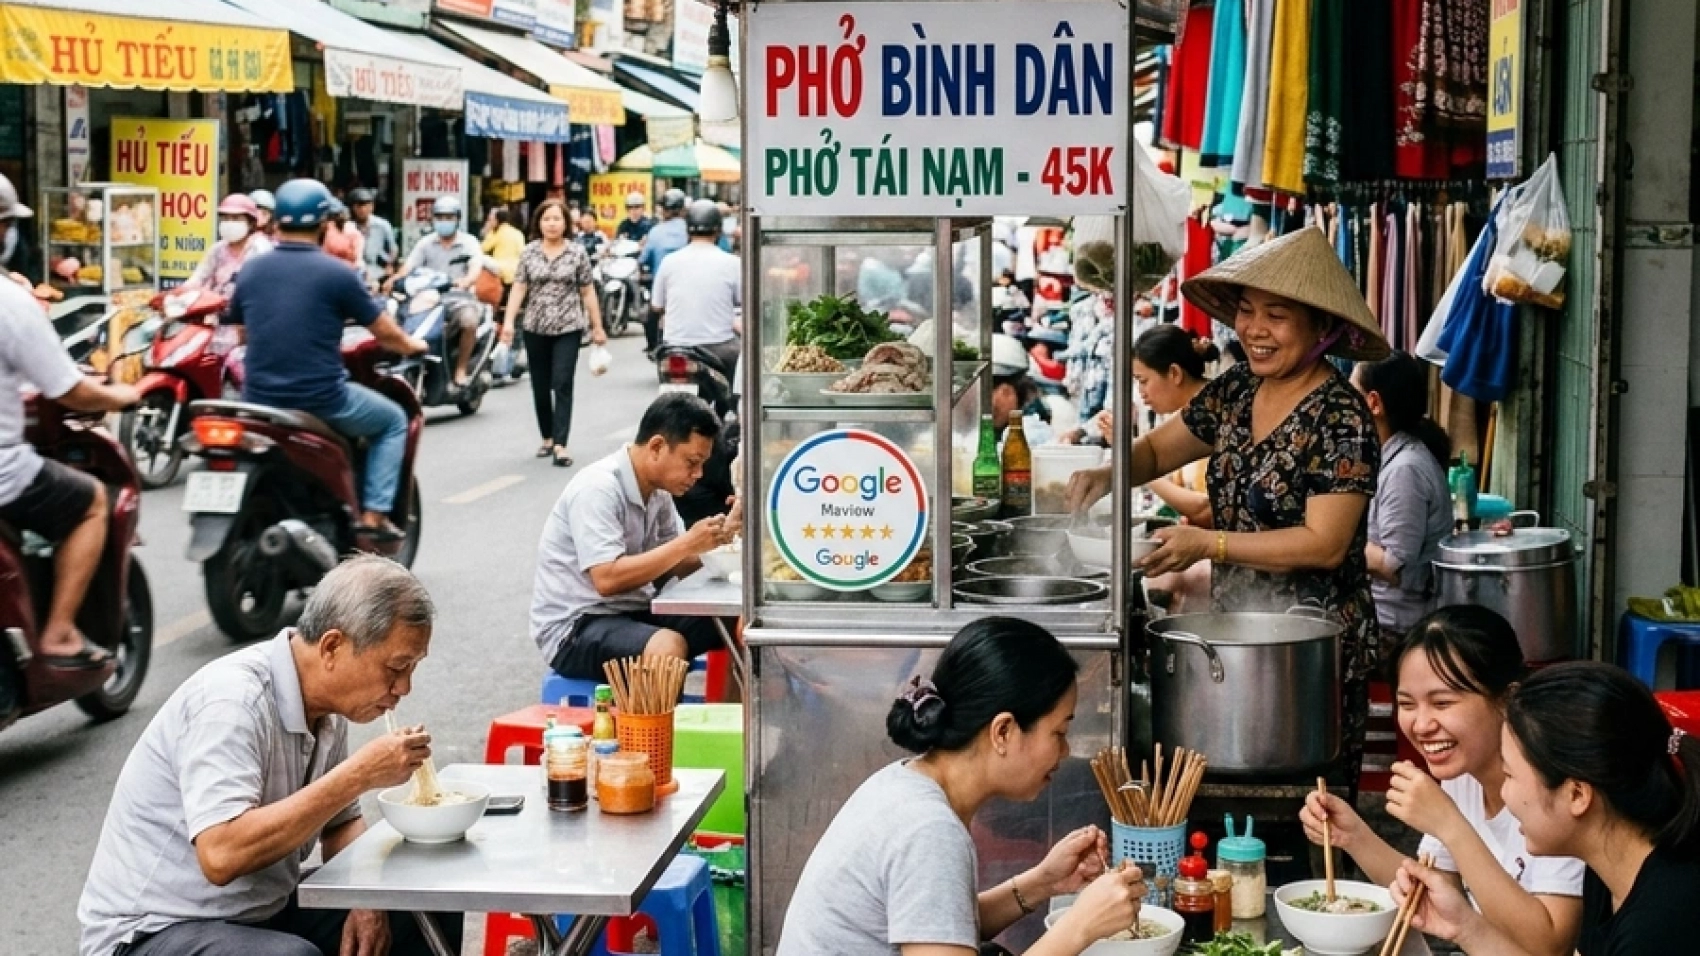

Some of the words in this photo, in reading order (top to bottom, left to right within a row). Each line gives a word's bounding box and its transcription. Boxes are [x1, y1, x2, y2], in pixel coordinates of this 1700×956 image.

[50, 22, 104, 75] HỦ
[116, 26, 197, 81] TIẾU
[766, 13, 866, 118] PHỞ
[881, 22, 995, 117] BÌNH
[1014, 20, 1114, 116] DÂN
[116, 125, 148, 174] HỦ
[156, 127, 209, 176] TIẾU
[765, 127, 842, 196] PHỞ
[850, 133, 908, 196] TÁI
[922, 146, 1004, 208] NẠM
[1041, 146, 1114, 196] 45K
[161, 192, 207, 225] HỌC
[794, 465, 902, 501] Google
